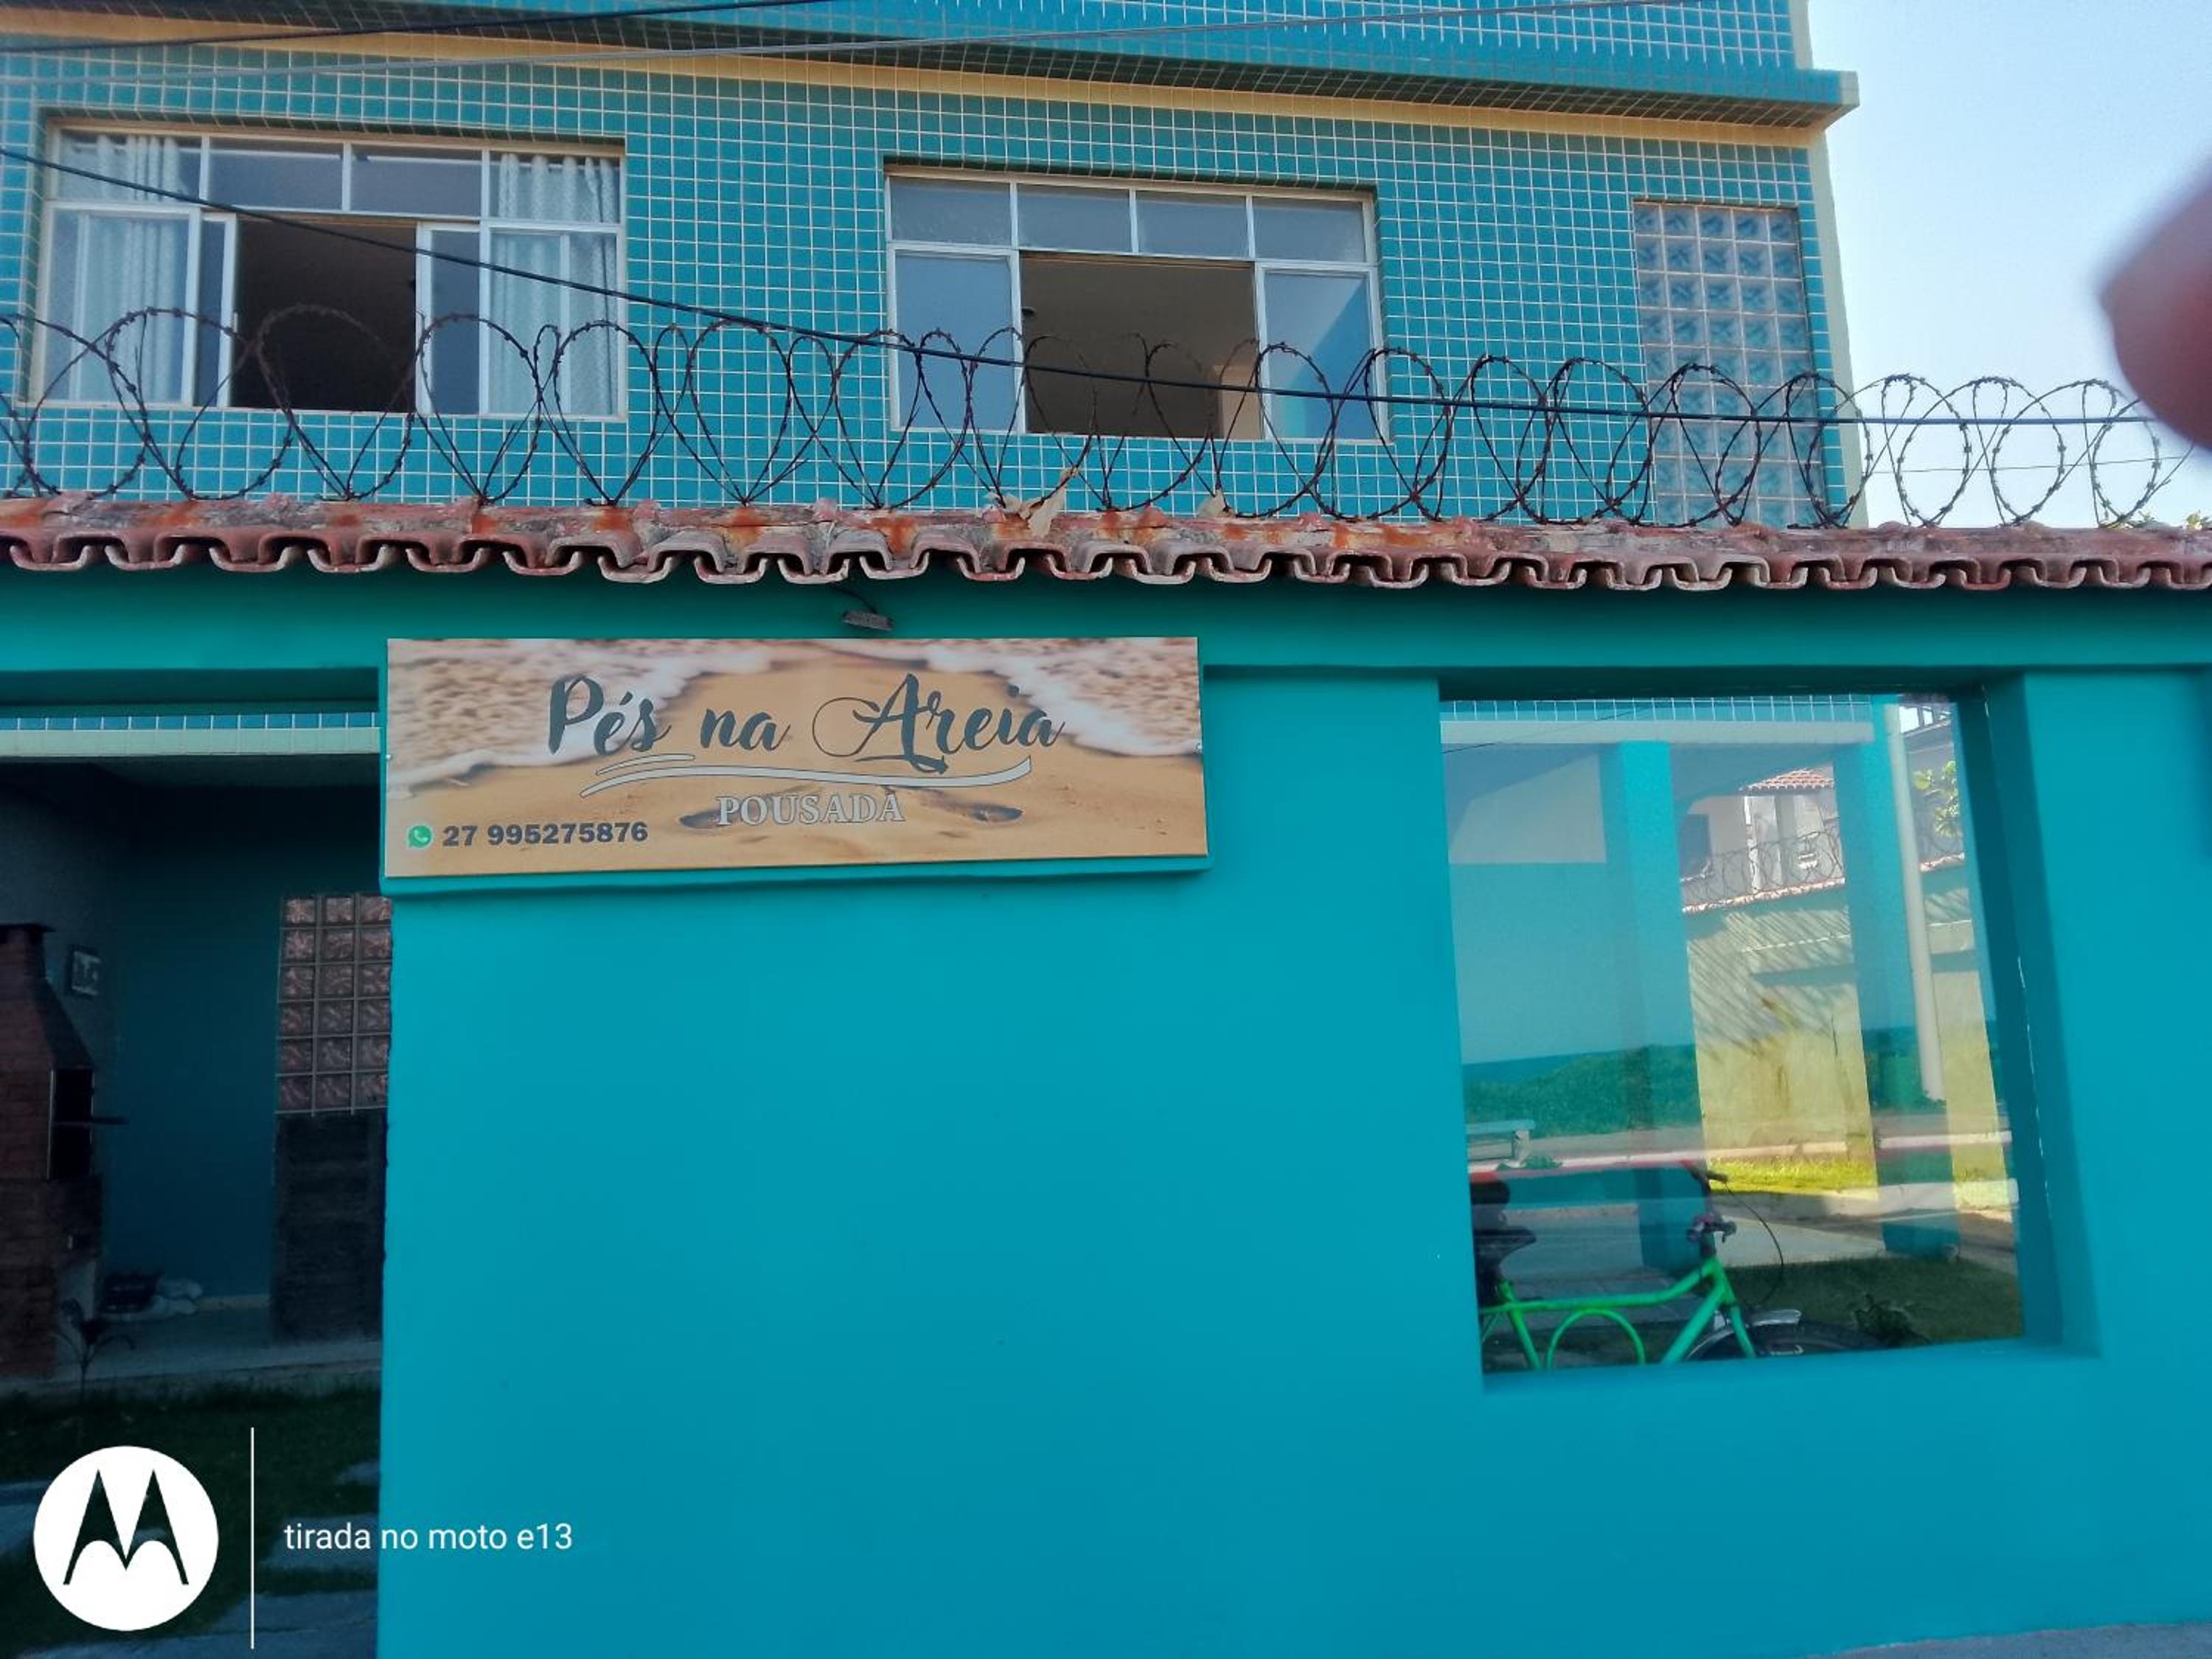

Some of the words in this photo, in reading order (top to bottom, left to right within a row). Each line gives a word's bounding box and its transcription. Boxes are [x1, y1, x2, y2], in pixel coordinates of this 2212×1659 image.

[546, 673, 671, 756] Pés
[700, 706, 792, 753] na
[812, 672, 1065, 775] Areia
[716, 792, 906, 827] POUSADA
[442, 824, 478, 848] 27
[487, 820, 649, 846] 995275876
